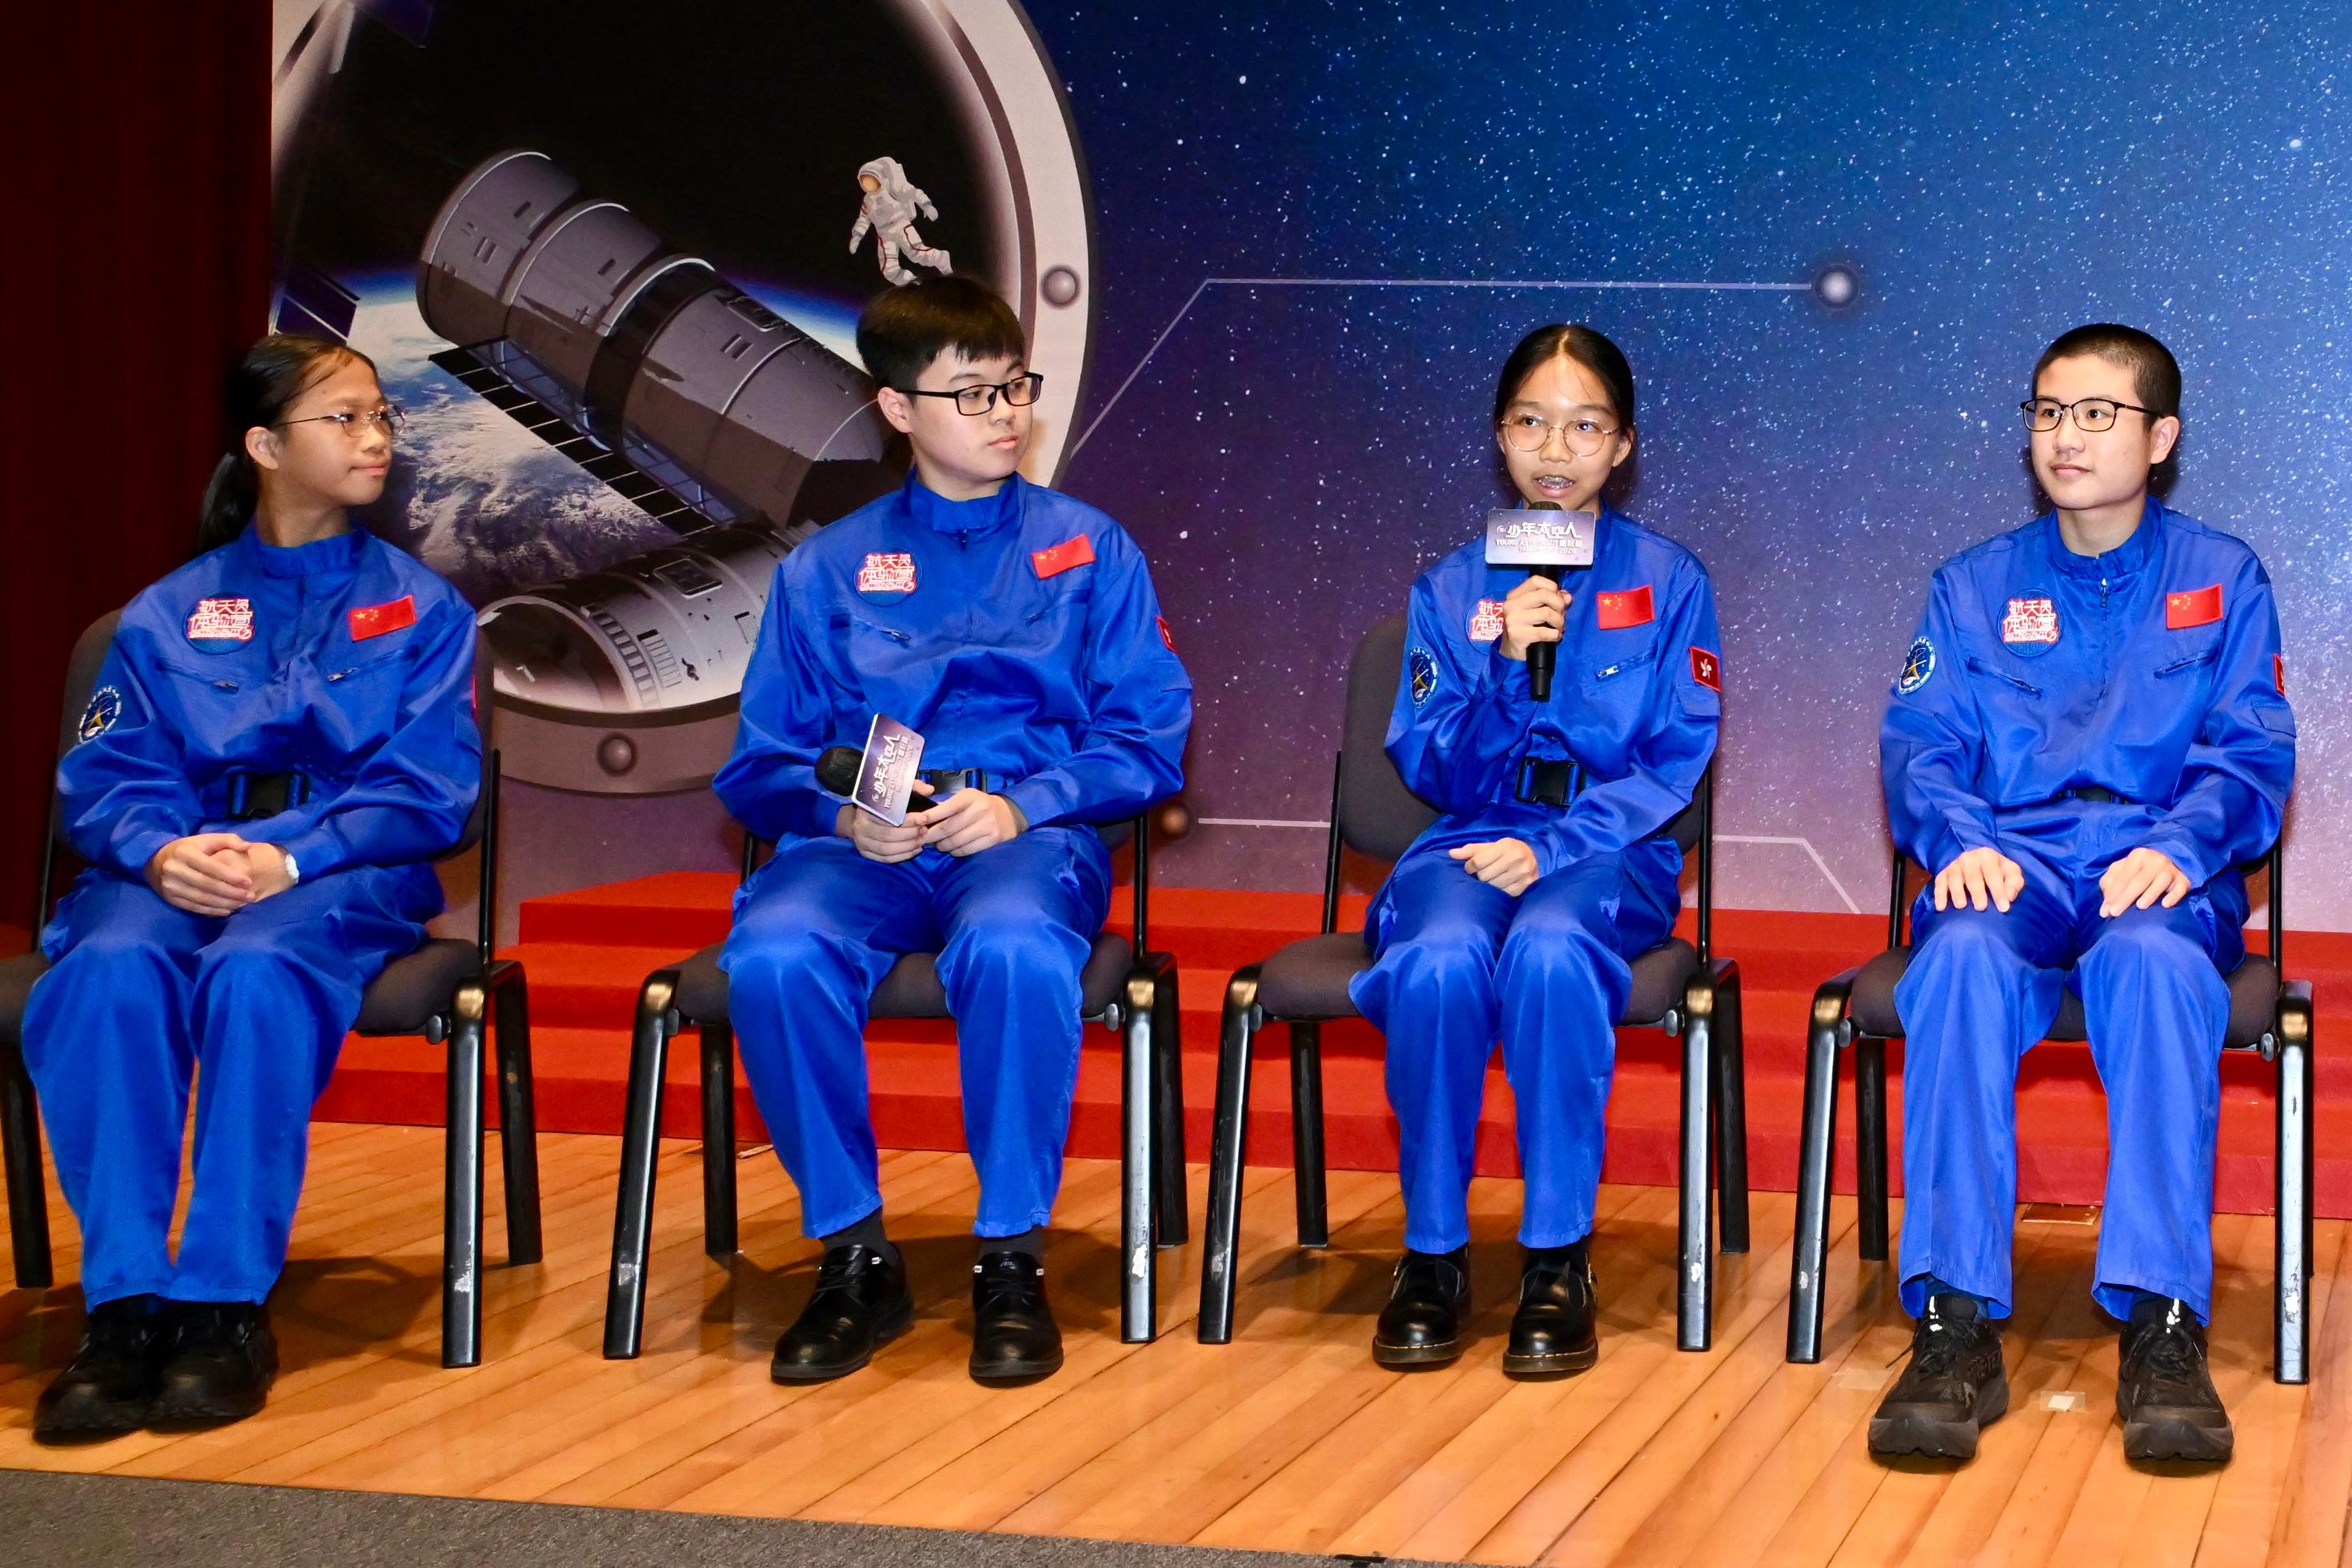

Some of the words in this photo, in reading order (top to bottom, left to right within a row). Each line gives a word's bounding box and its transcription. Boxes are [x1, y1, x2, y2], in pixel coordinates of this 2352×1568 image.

[1505, 521, 1583, 539] 少年太空人
[866, 554, 912, 568] 航天员
[199, 599, 250, 614] 航天员
[1479, 600, 1503, 616] 航天
[2008, 600, 2053, 616] 航天员
[1471, 615, 1504, 632] 体验
[874, 734, 900, 798] 少年太空人
